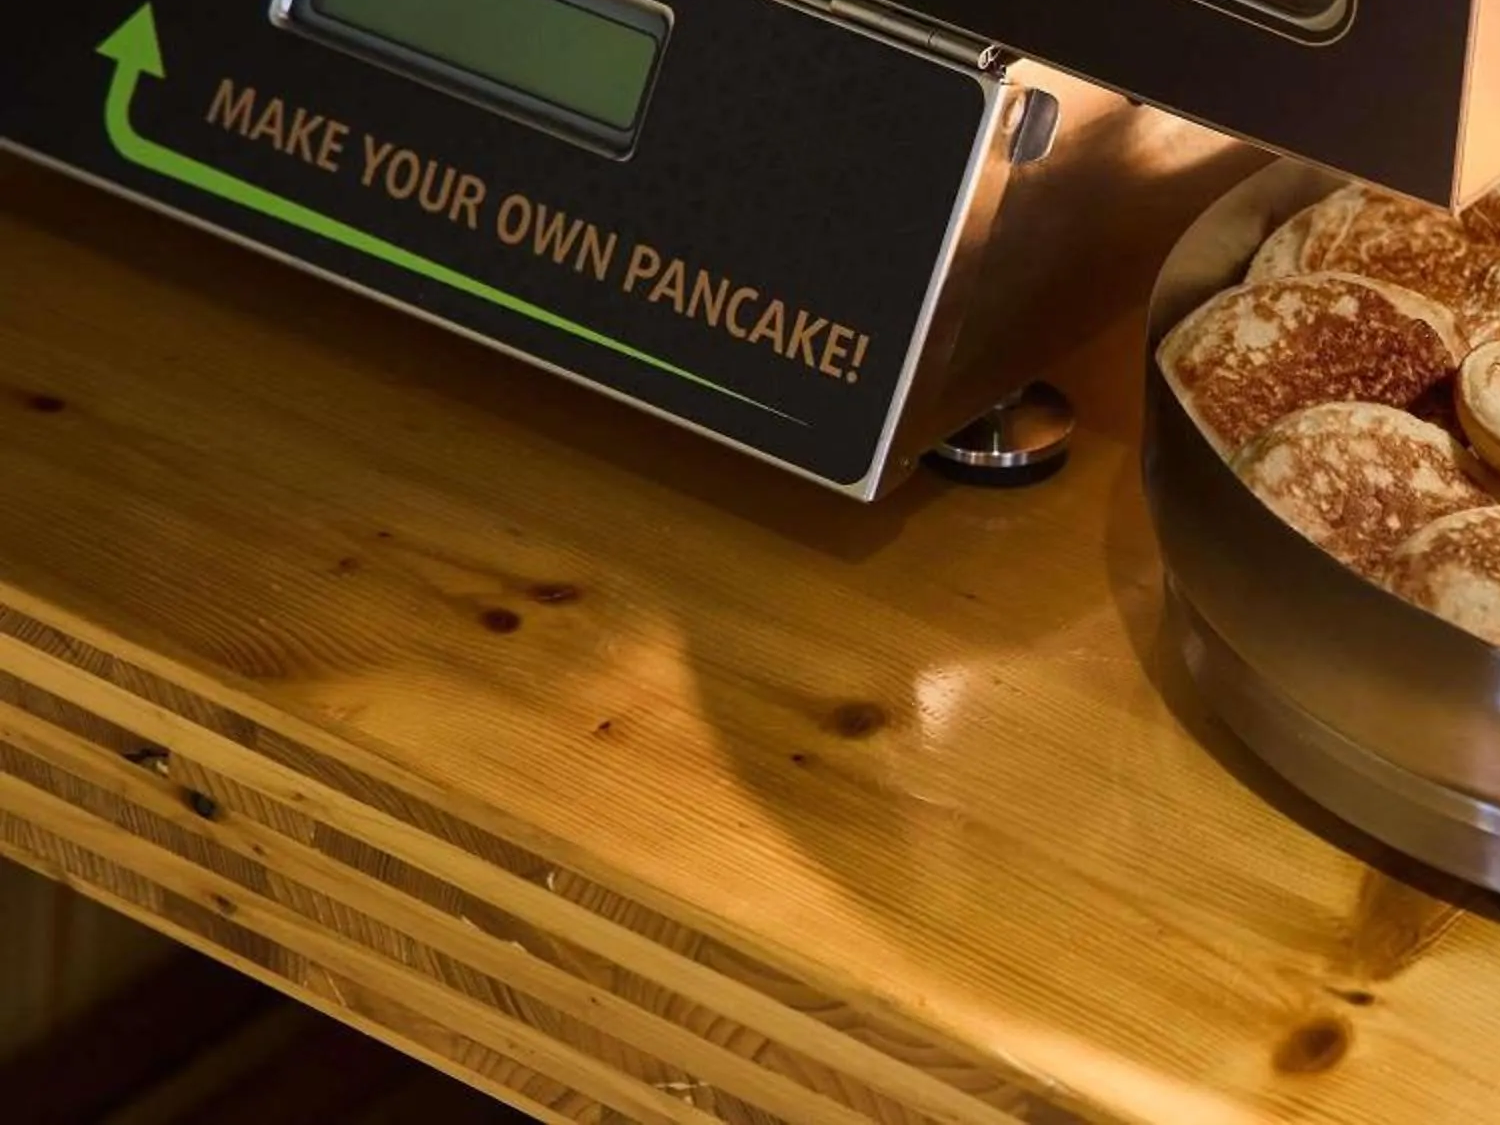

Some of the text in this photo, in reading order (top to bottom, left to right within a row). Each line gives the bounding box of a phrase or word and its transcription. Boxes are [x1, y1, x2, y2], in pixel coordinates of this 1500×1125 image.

[204, 78, 870, 384] MAKE YOUR OWN PANCAKE!
